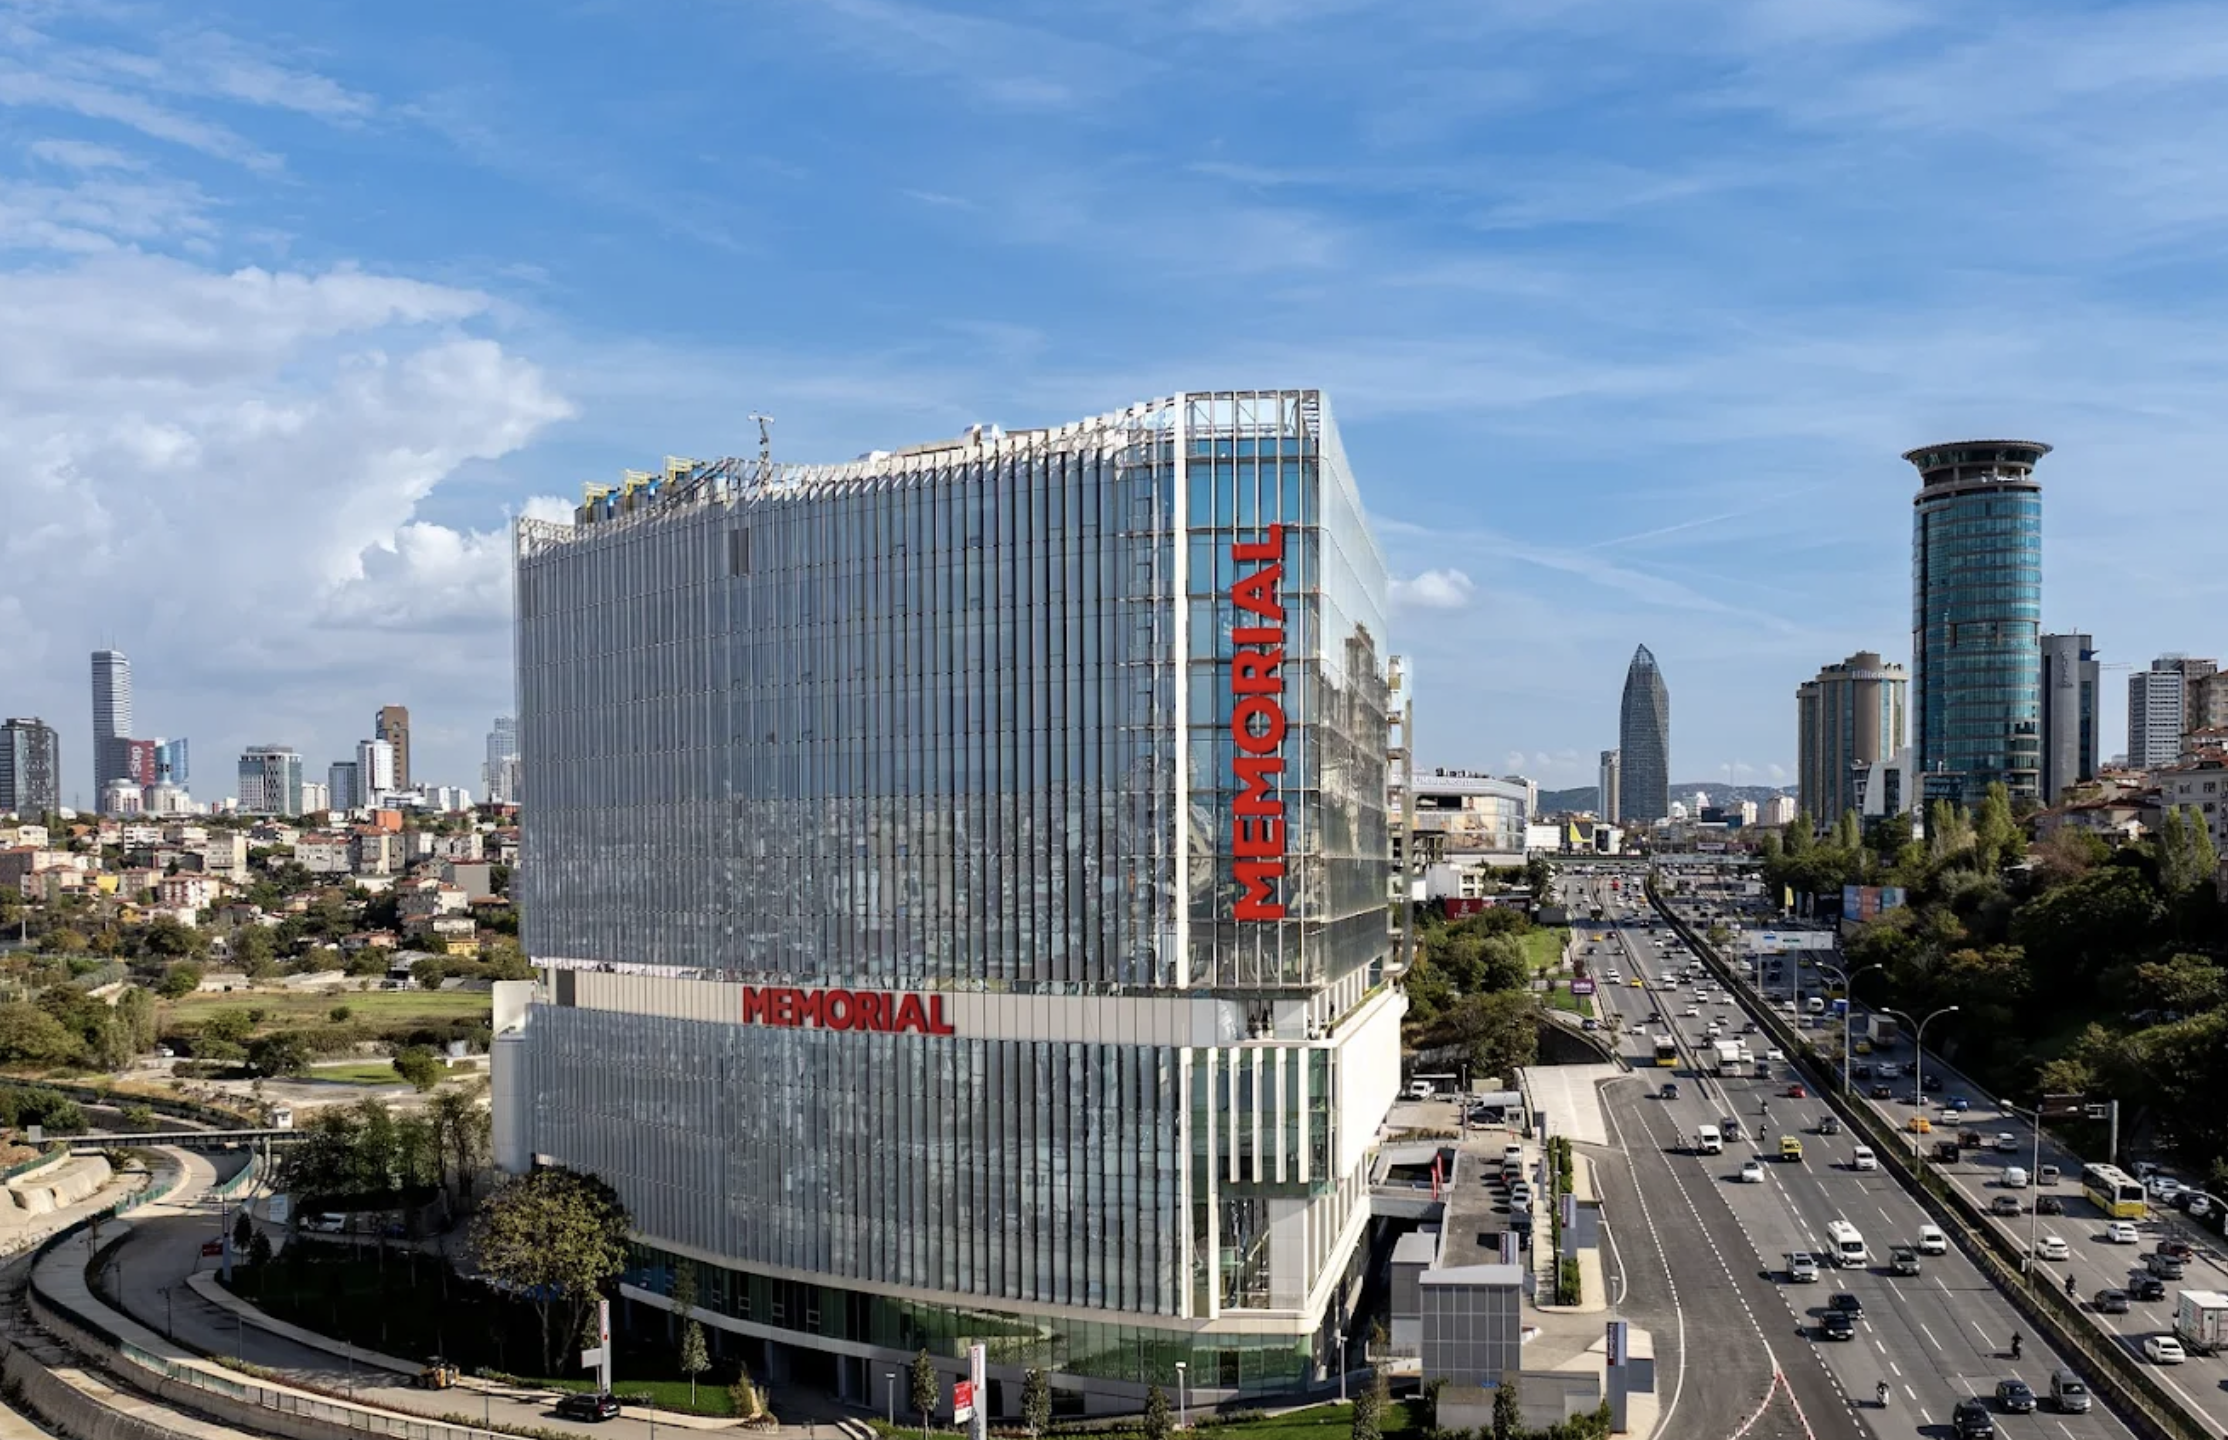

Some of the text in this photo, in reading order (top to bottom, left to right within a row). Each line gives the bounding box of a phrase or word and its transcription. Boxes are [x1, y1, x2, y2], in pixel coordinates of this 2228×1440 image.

[1852, 669, 1885, 680] Hilton
[1232, 523, 1285, 921] MEMORIAL
[743, 986, 954, 1035] MEMORIAL
